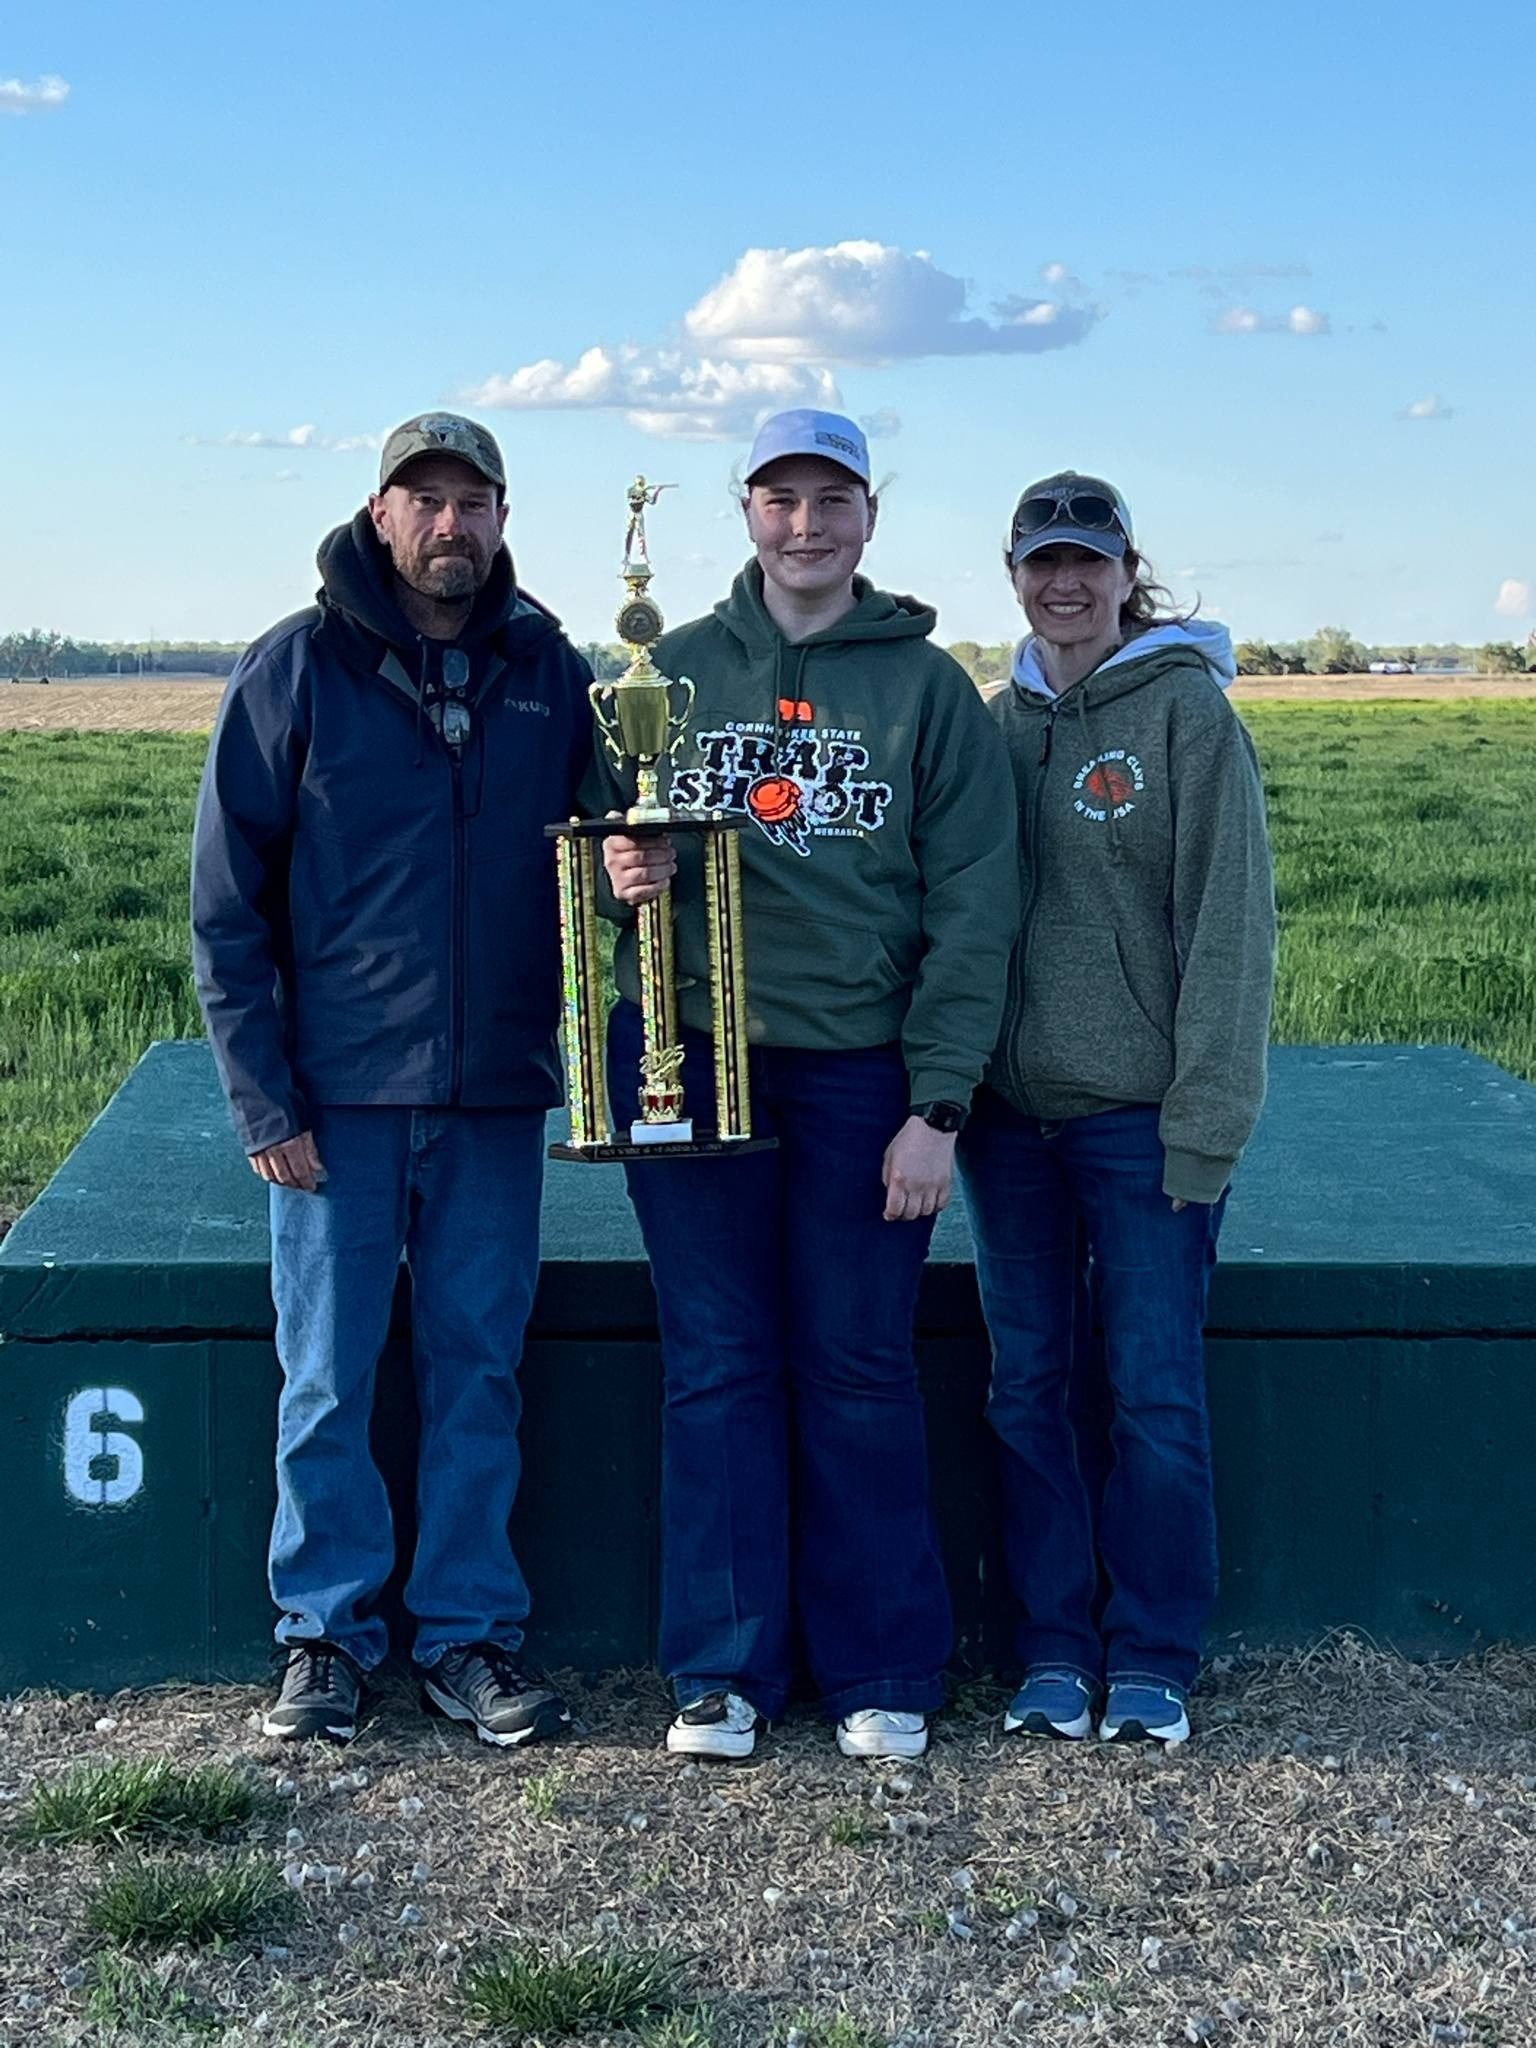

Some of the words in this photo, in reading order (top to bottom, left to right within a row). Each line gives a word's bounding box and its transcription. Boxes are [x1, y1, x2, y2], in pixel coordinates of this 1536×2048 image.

[725, 721, 817, 739] CORNHKER
[821, 728, 861, 741] STATE
[697, 731, 870, 786] TRAP
[1126, 755, 1145, 791] CLAYS
[1083, 807, 1107, 821] THE
[814, 827, 864, 838] NEBRASKA
[64, 1387, 145, 1505] 6
